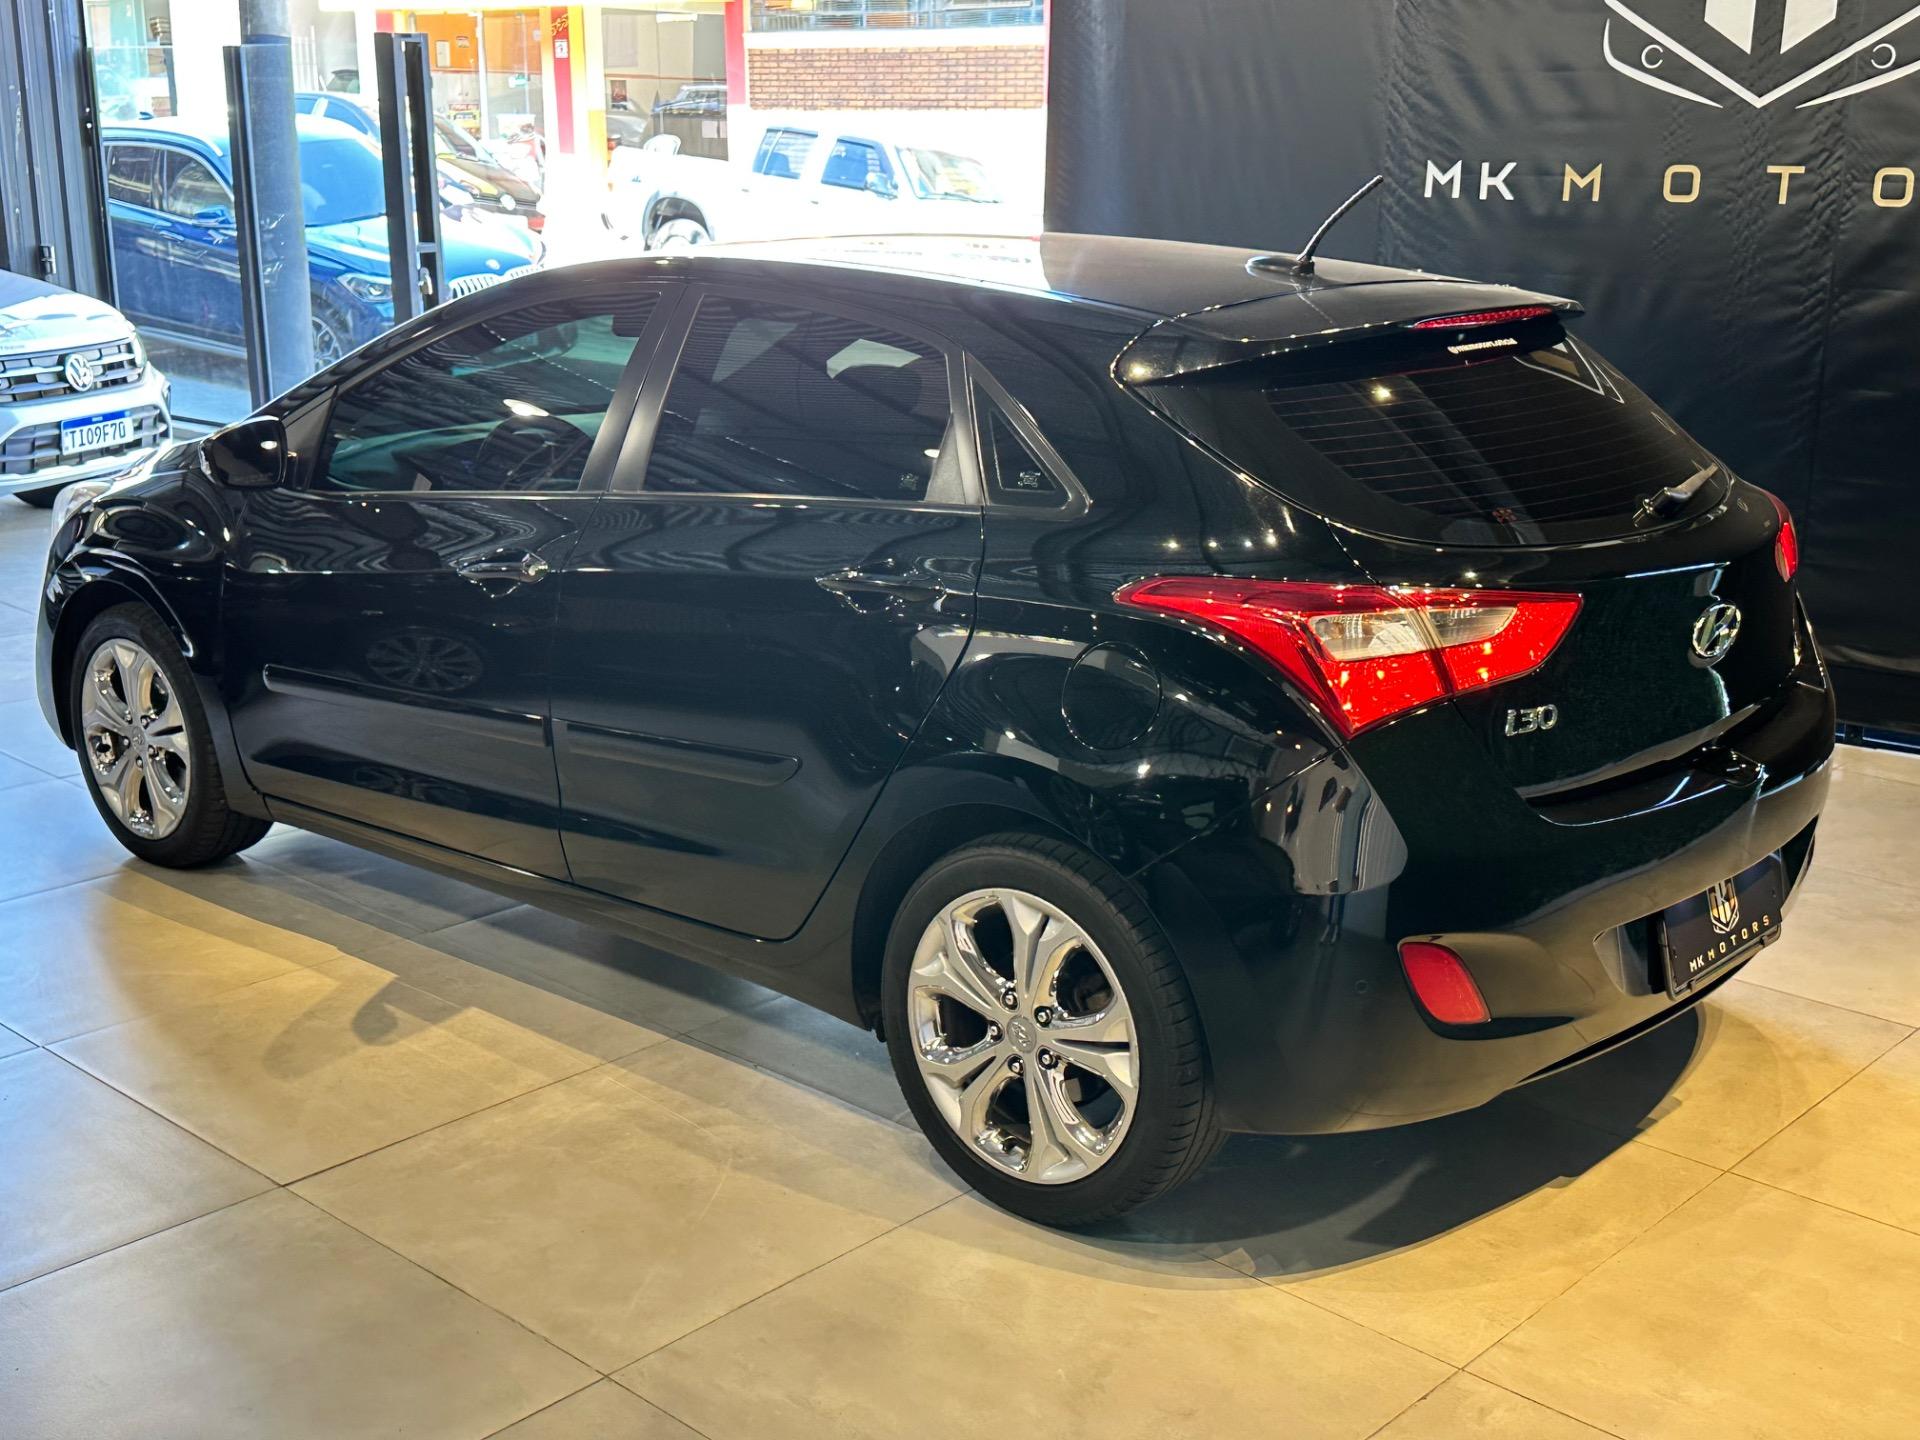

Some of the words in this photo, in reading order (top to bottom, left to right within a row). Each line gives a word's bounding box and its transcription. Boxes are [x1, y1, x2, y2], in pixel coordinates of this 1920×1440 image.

[1423, 159, 1518, 201] MK
[1561, 162, 1915, 208] MOTO
[1504, 703, 1559, 737] i30
[1689, 954, 1705, 973] MK
[1707, 914, 1771, 961] MOTORS
